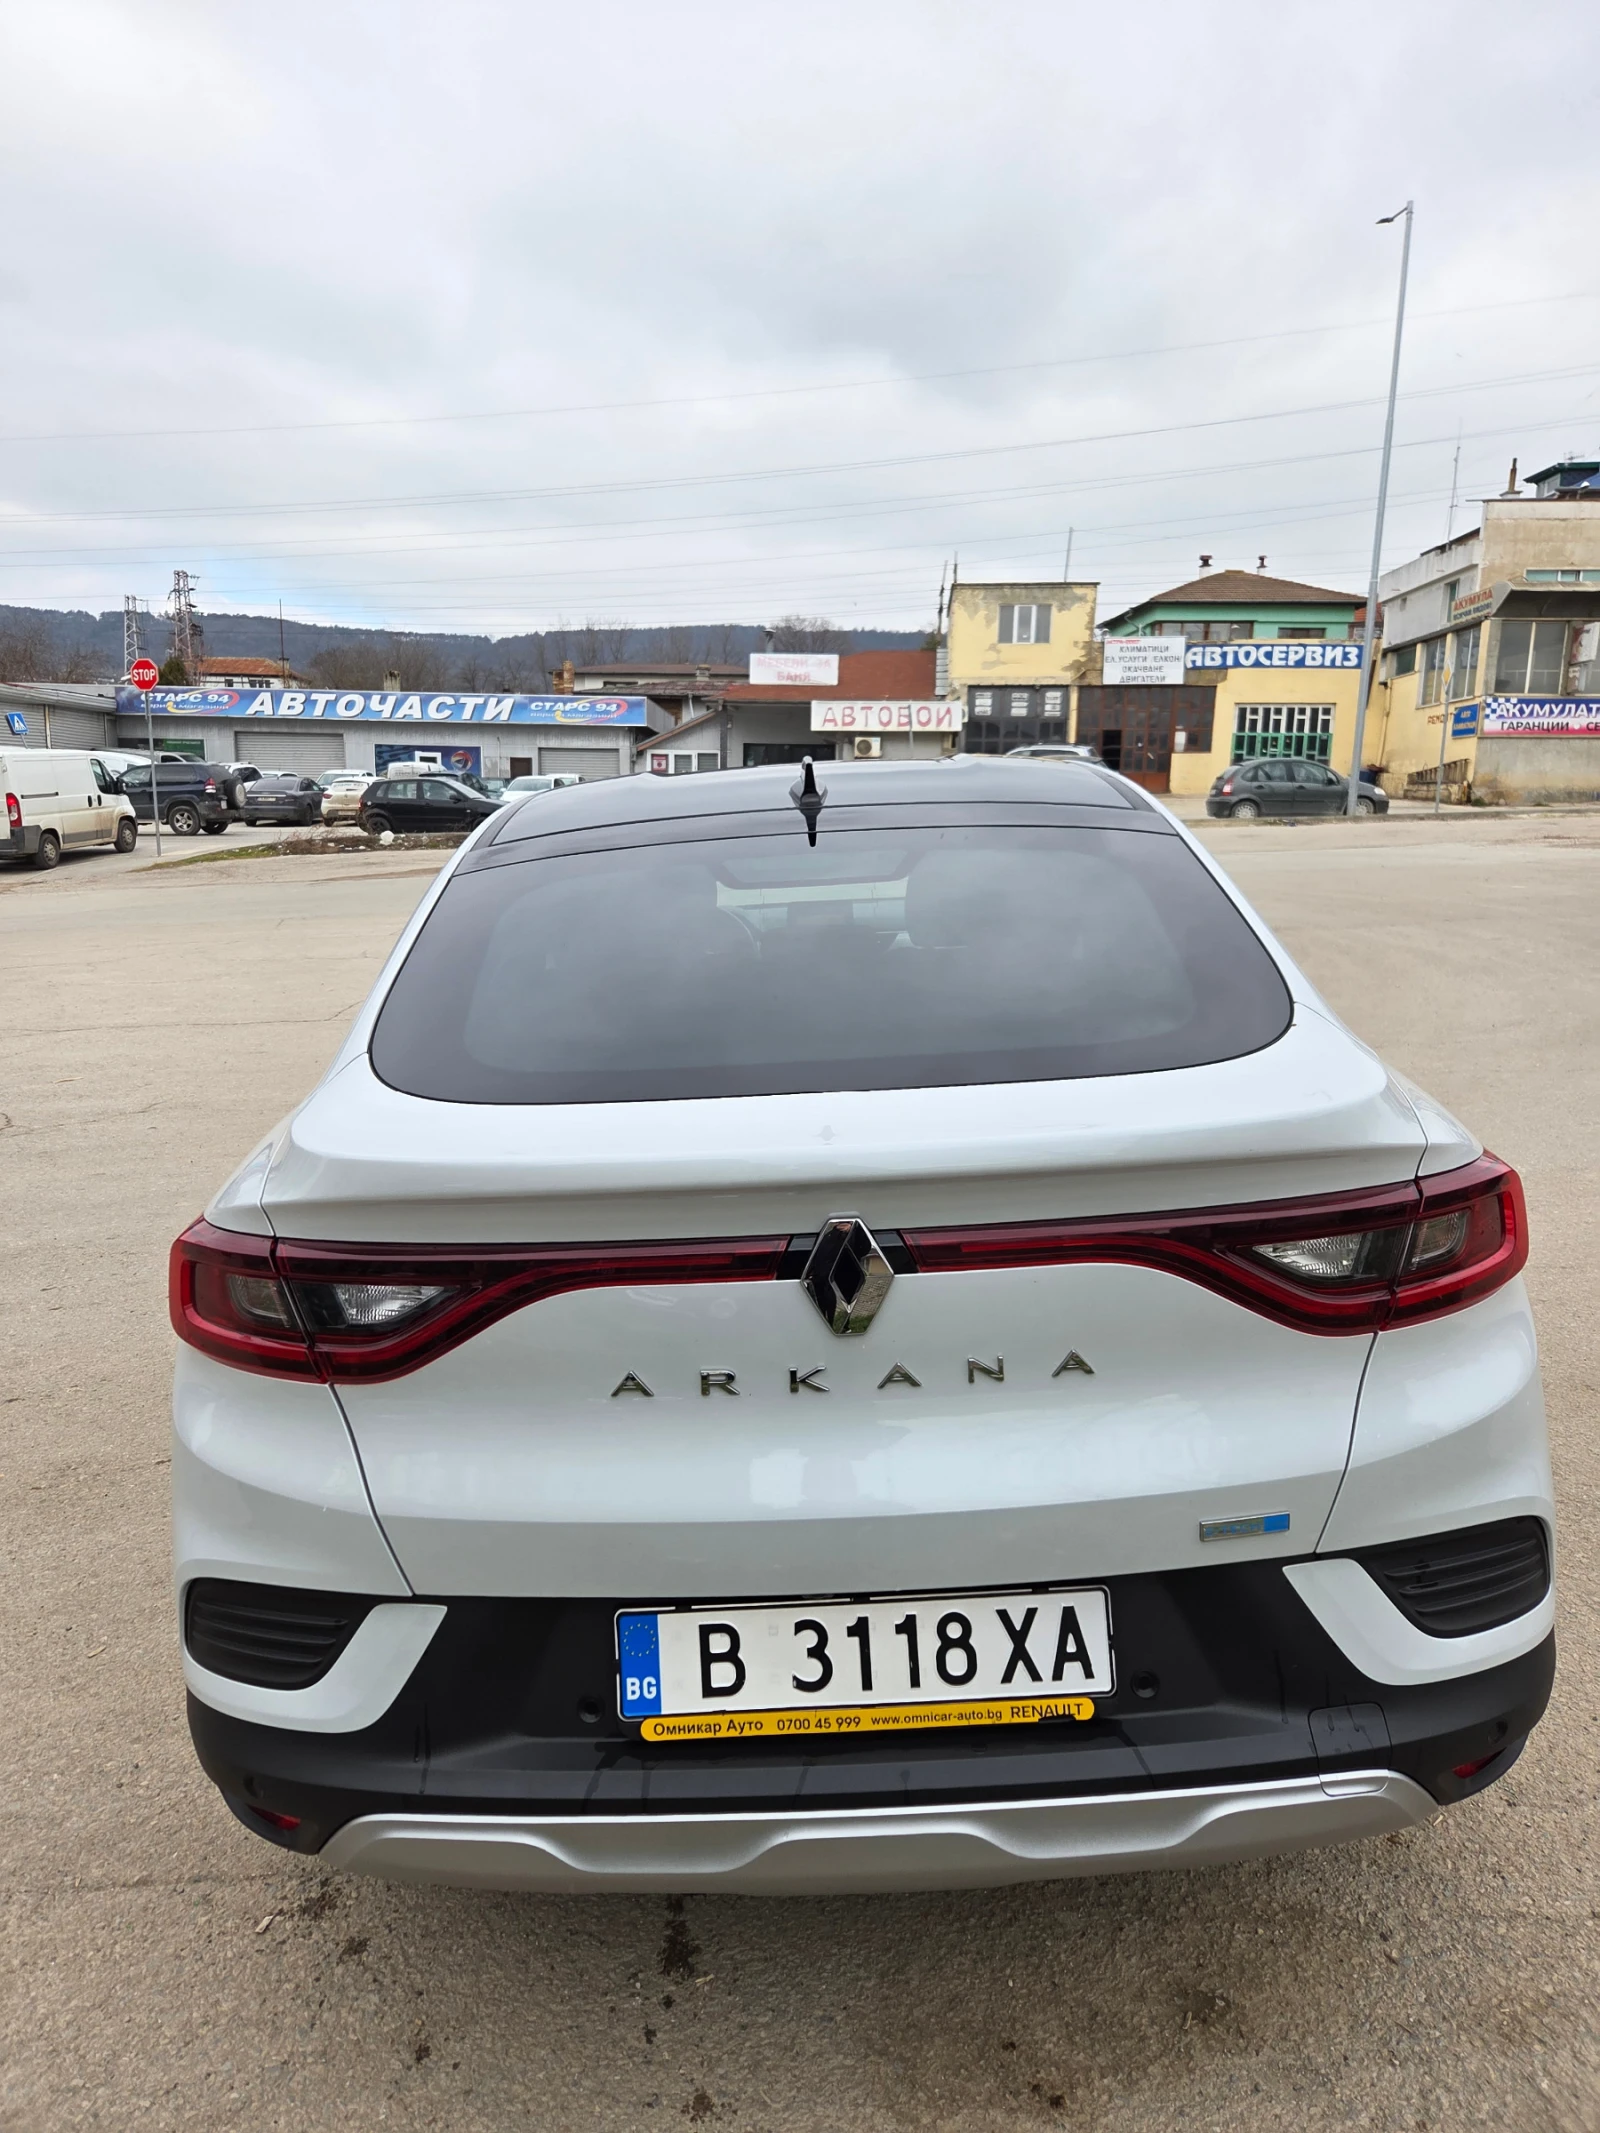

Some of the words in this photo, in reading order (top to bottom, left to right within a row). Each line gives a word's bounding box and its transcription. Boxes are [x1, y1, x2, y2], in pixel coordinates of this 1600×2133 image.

[1185, 645, 1359, 668] АВТОСЕРВИЗ
[132, 668, 156, 681] STOP
[1119, 675, 1167, 684] ДВИГАТЕЛИ
[140, 692, 202, 703] СТАРС
[207, 693, 230, 704] 94
[245, 691, 515, 721] АВТОЧАСТИ
[530, 702, 591, 712] СТАРС
[595, 703, 618, 712] 94
[822, 705, 952, 728] АВТОБОИ
[1496, 703, 1600, 719] АКУМУЛАТ
[1501, 721, 1570, 732] ГАРАНЦИИ
[611, 1348, 1095, 1397] ARKANA
[698, 1622, 746, 1699] B
[791, 1611, 978, 1693] 3118
[995, 1605, 1096, 1685] XA
[626, 1677, 657, 1701] BG
[653, 1720, 722, 1737] Омникар
[726, 1718, 764, 1735] Ауто
[776, 1718, 811, 1732] 0700
[815, 1718, 832, 1731] 45
[836, 1716, 862, 1731] 999
[870, 1708, 1003, 1726] www.omnicar-auto.bg
[1009, 1702, 1084, 1719] RENAULT
